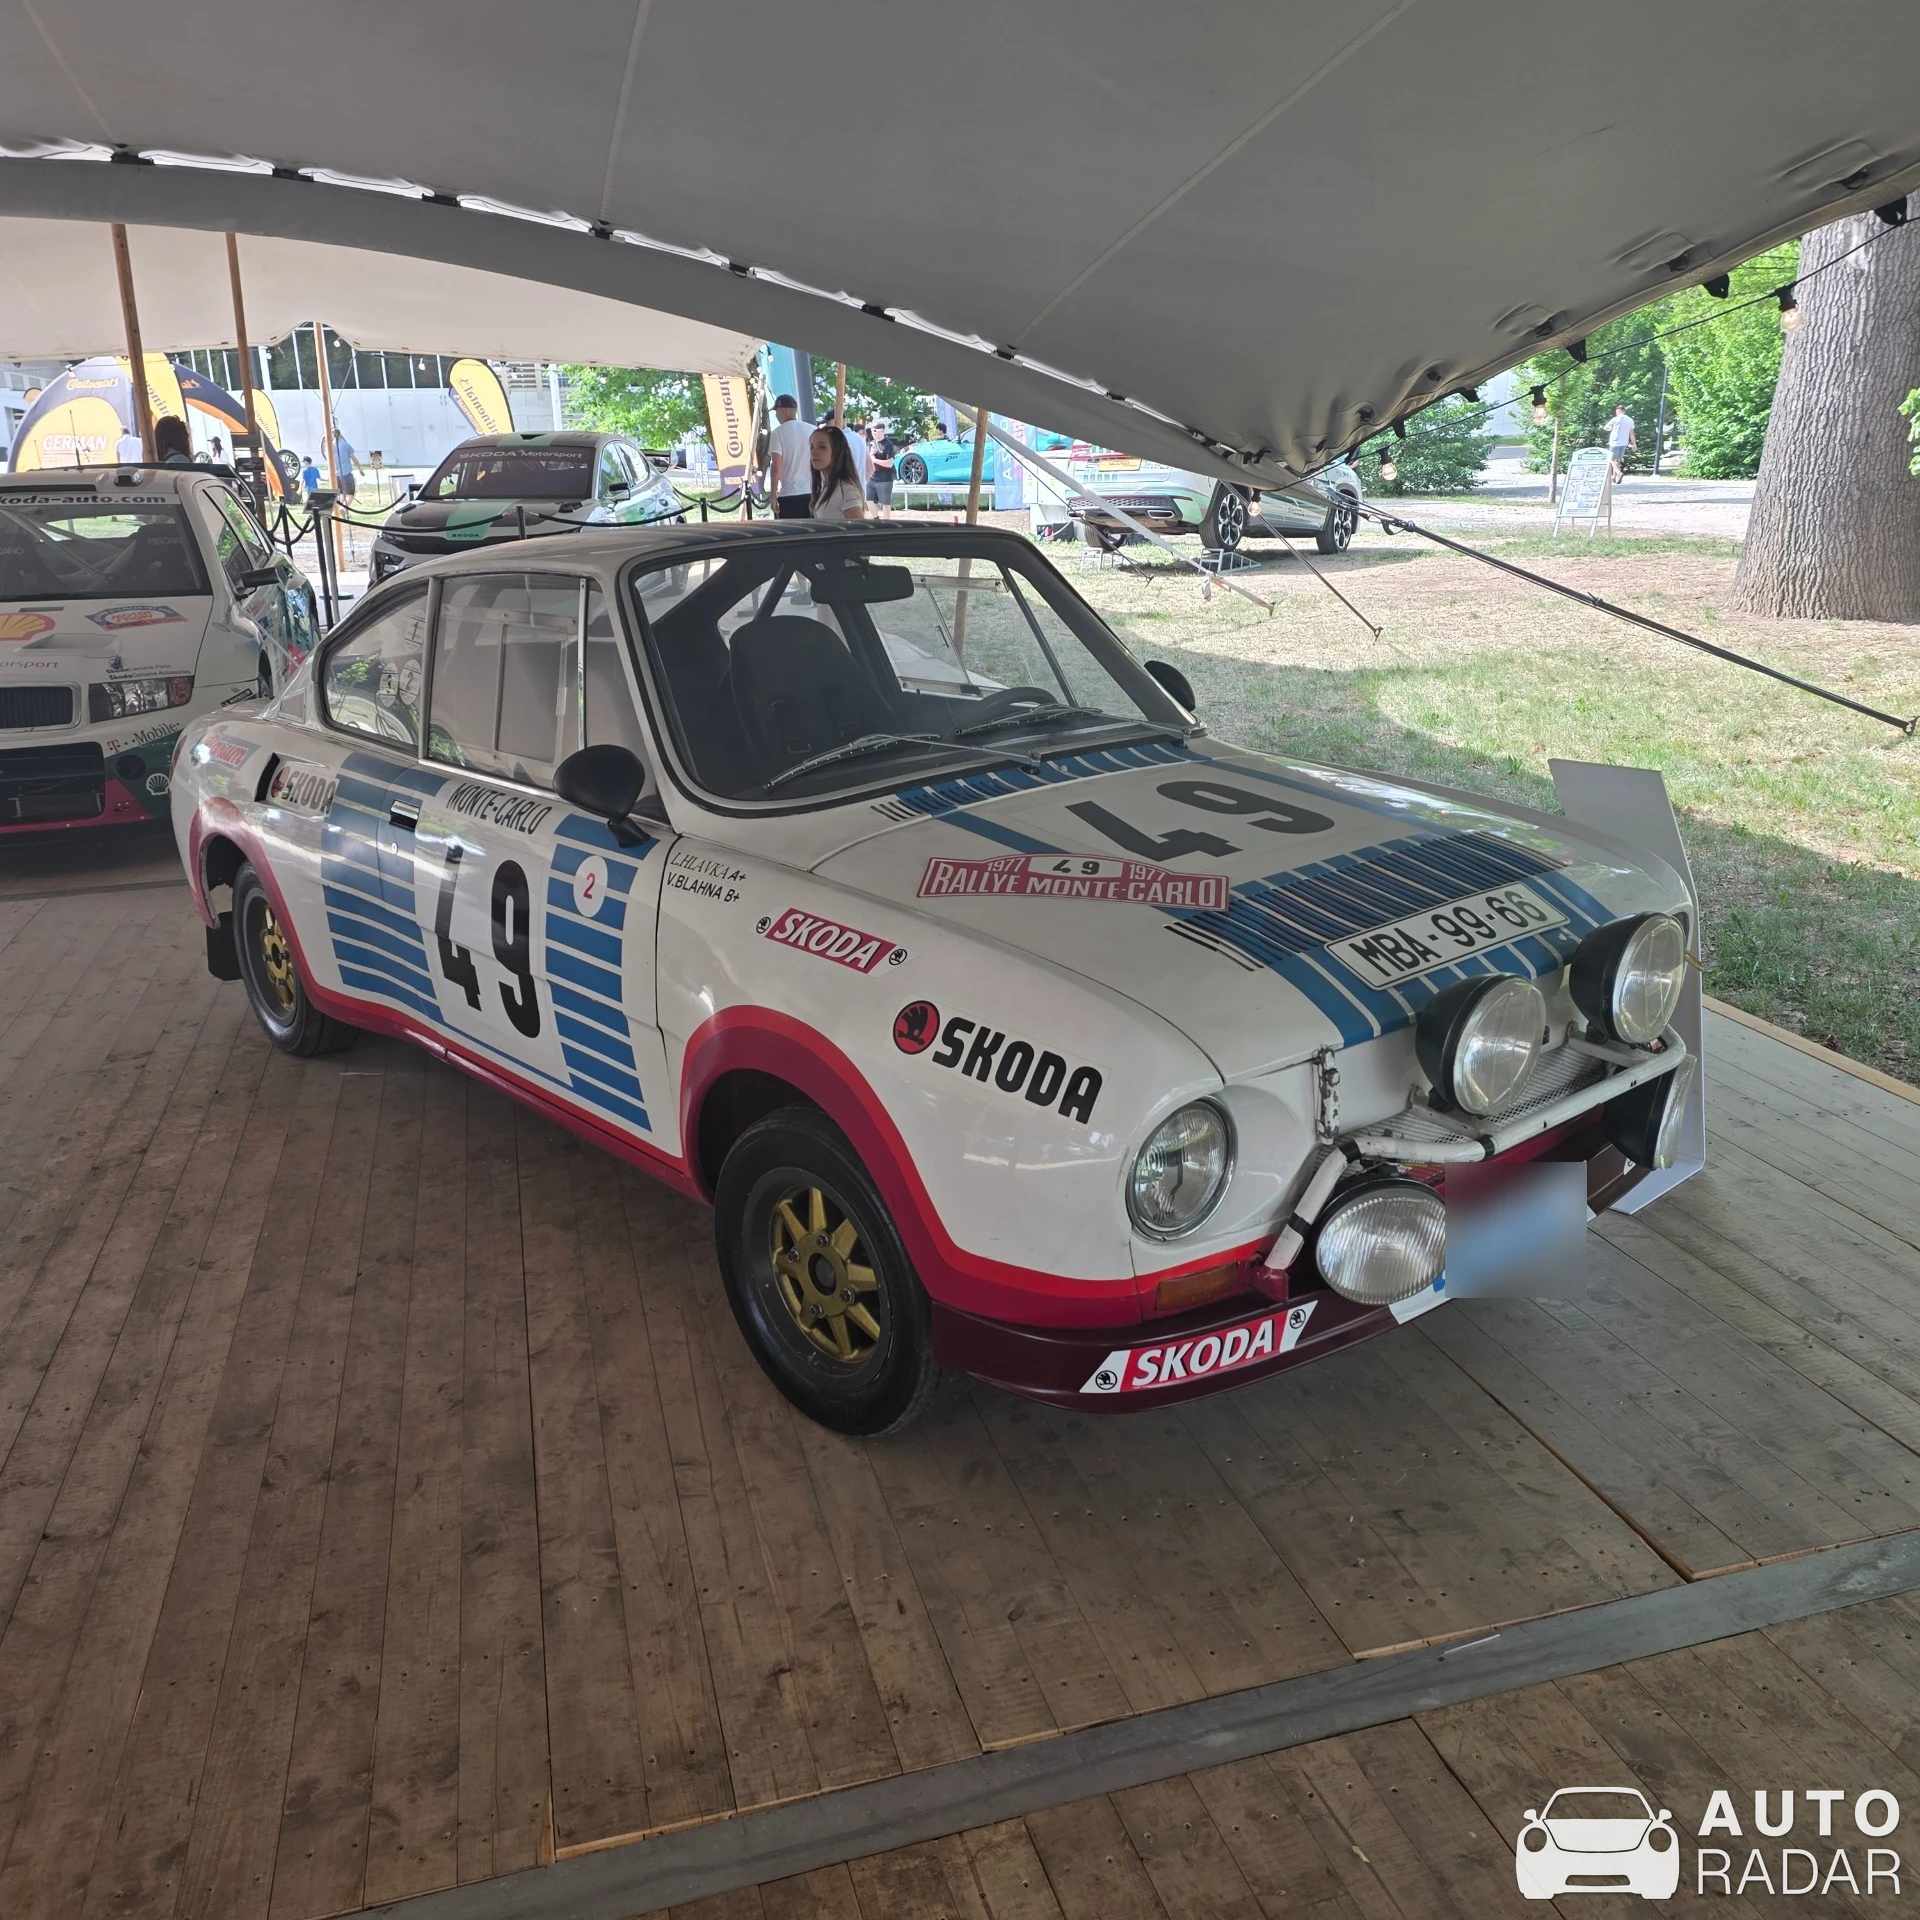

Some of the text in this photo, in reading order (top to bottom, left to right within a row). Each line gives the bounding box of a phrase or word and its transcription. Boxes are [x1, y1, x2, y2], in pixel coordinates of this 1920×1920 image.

[43, 434, 107, 451] GERMAN
[521, 450, 583, 459] Motorsport
[0, 494, 166, 505] koda-auto.com
[147, 537, 184, 546] RECAR
[0, 660, 60, 669] orsport
[282, 770, 337, 815] SKODA
[446, 782, 553, 835] MONTE-CARLO
[1064, 780, 1335, 862] 49
[583, 872, 597, 900] 2
[666, 871, 740, 903] V.BLAHNA B+
[929, 862, 1217, 907] RALLYE MONTE-CARLO
[986, 857, 1166, 882] 1977 49 1977
[434, 845, 541, 1039] 49
[773, 913, 882, 969] SKODA
[932, 1016, 1103, 1125] SKODA
[1131, 1319, 1274, 1387] SKODA
